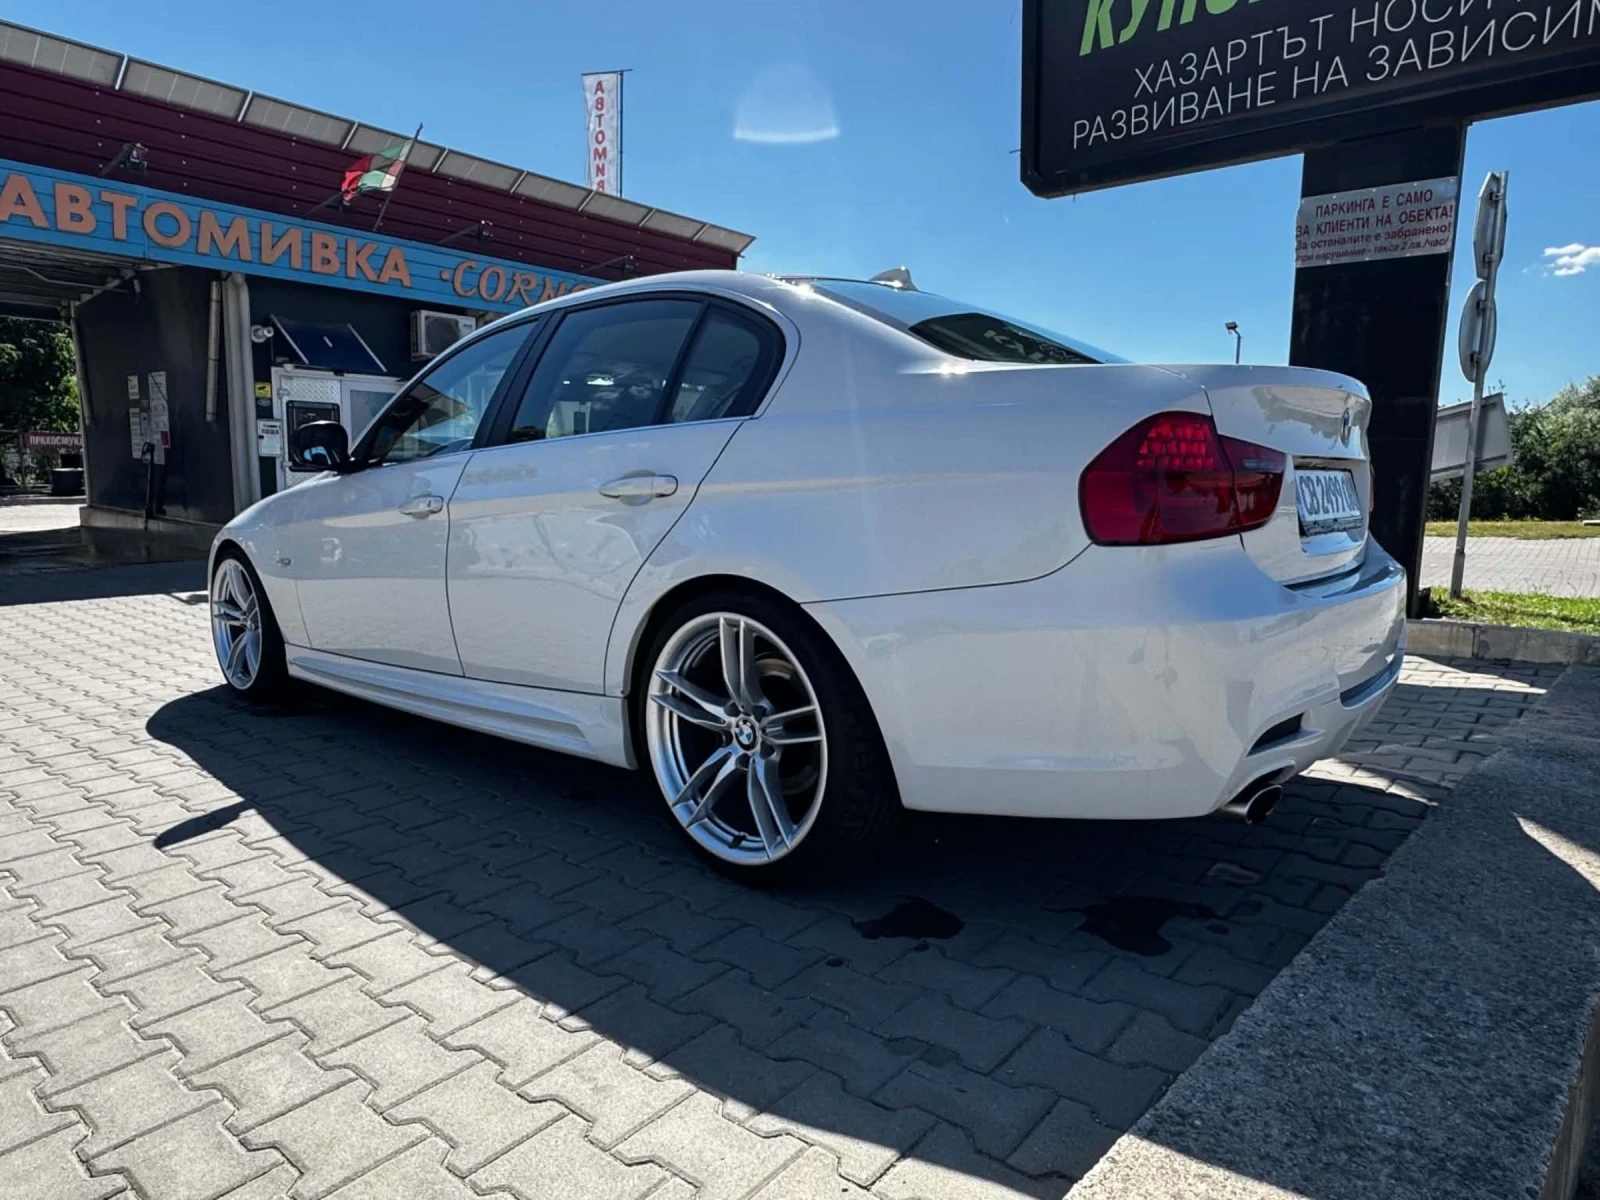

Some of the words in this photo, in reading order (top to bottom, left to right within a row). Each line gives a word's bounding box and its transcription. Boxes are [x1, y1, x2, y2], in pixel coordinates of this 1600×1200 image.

[1134, 14, 1334, 98] ХАЗАРТЪТ
[1073, 71, 1277, 150] РАЗВИВАНЕ
[1292, 56, 1349, 99] НА
[0, 174, 412, 288] АВТОМИВКА
[1315, 199, 1375, 218] ПАРКИНГА
[1382, 195, 1390, 209] Е
[1396, 189, 1433, 206] САМО
[1316, 216, 1370, 235] КЛИЕНТИ
[1376, 213, 1392, 228] НА
[1399, 204, 1453, 224] ОБЕКТА!
[1310, 234, 1371, 249] останалите
[1384, 222, 1452, 240] забранено!
